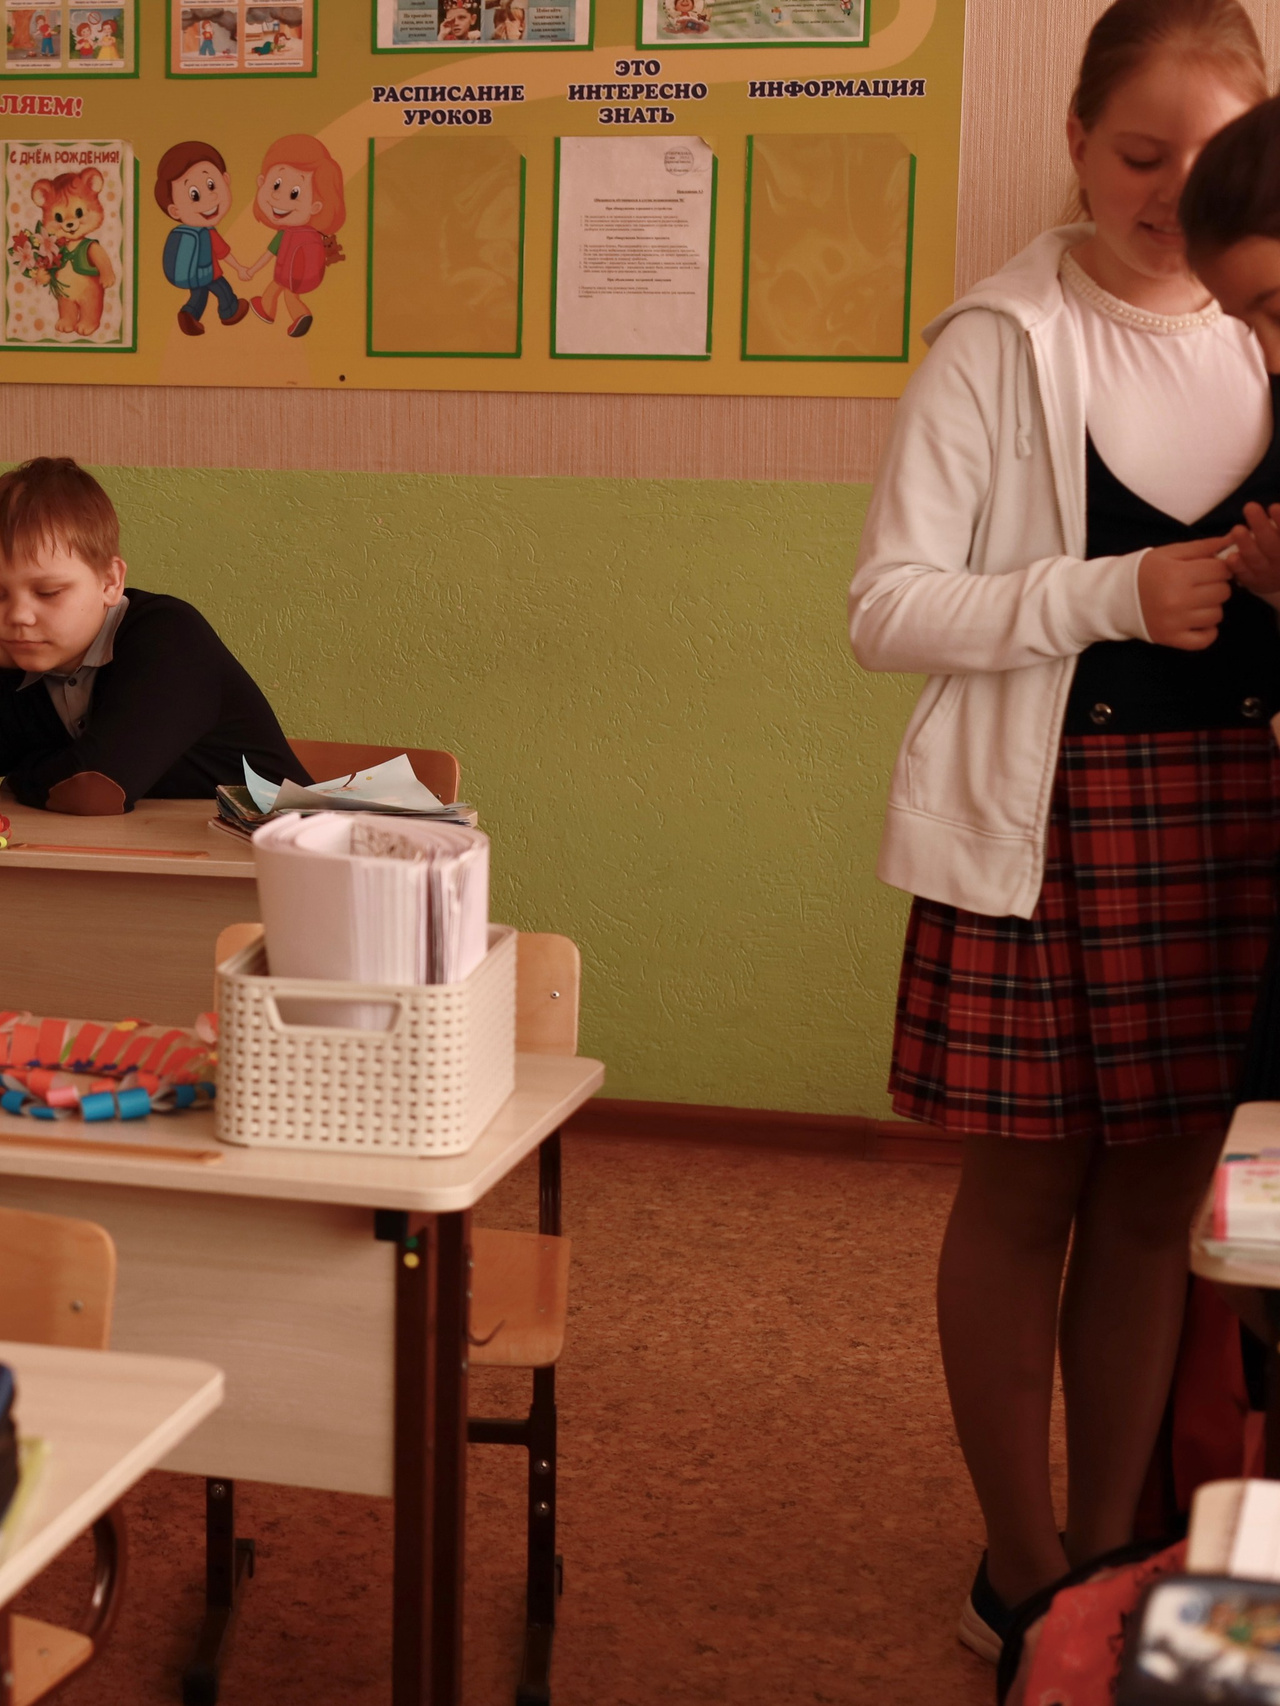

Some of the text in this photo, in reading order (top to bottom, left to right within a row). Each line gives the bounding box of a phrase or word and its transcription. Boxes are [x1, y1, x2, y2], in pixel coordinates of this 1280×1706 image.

[615, 60, 661, 76] ЭТО
[372, 85, 525, 102] РАСПИСАНИЕ
[568, 83, 707, 100] ИНТЕРЕСНО
[748, 80, 925, 98] ИНФОРМАЦИЯ
[404, 109, 492, 125] УРОКОВ
[598, 107, 675, 123] ЗНАТЬ
[10, 149, 119, 165] С ДНЁМ РОЖДЕНИЯ!
